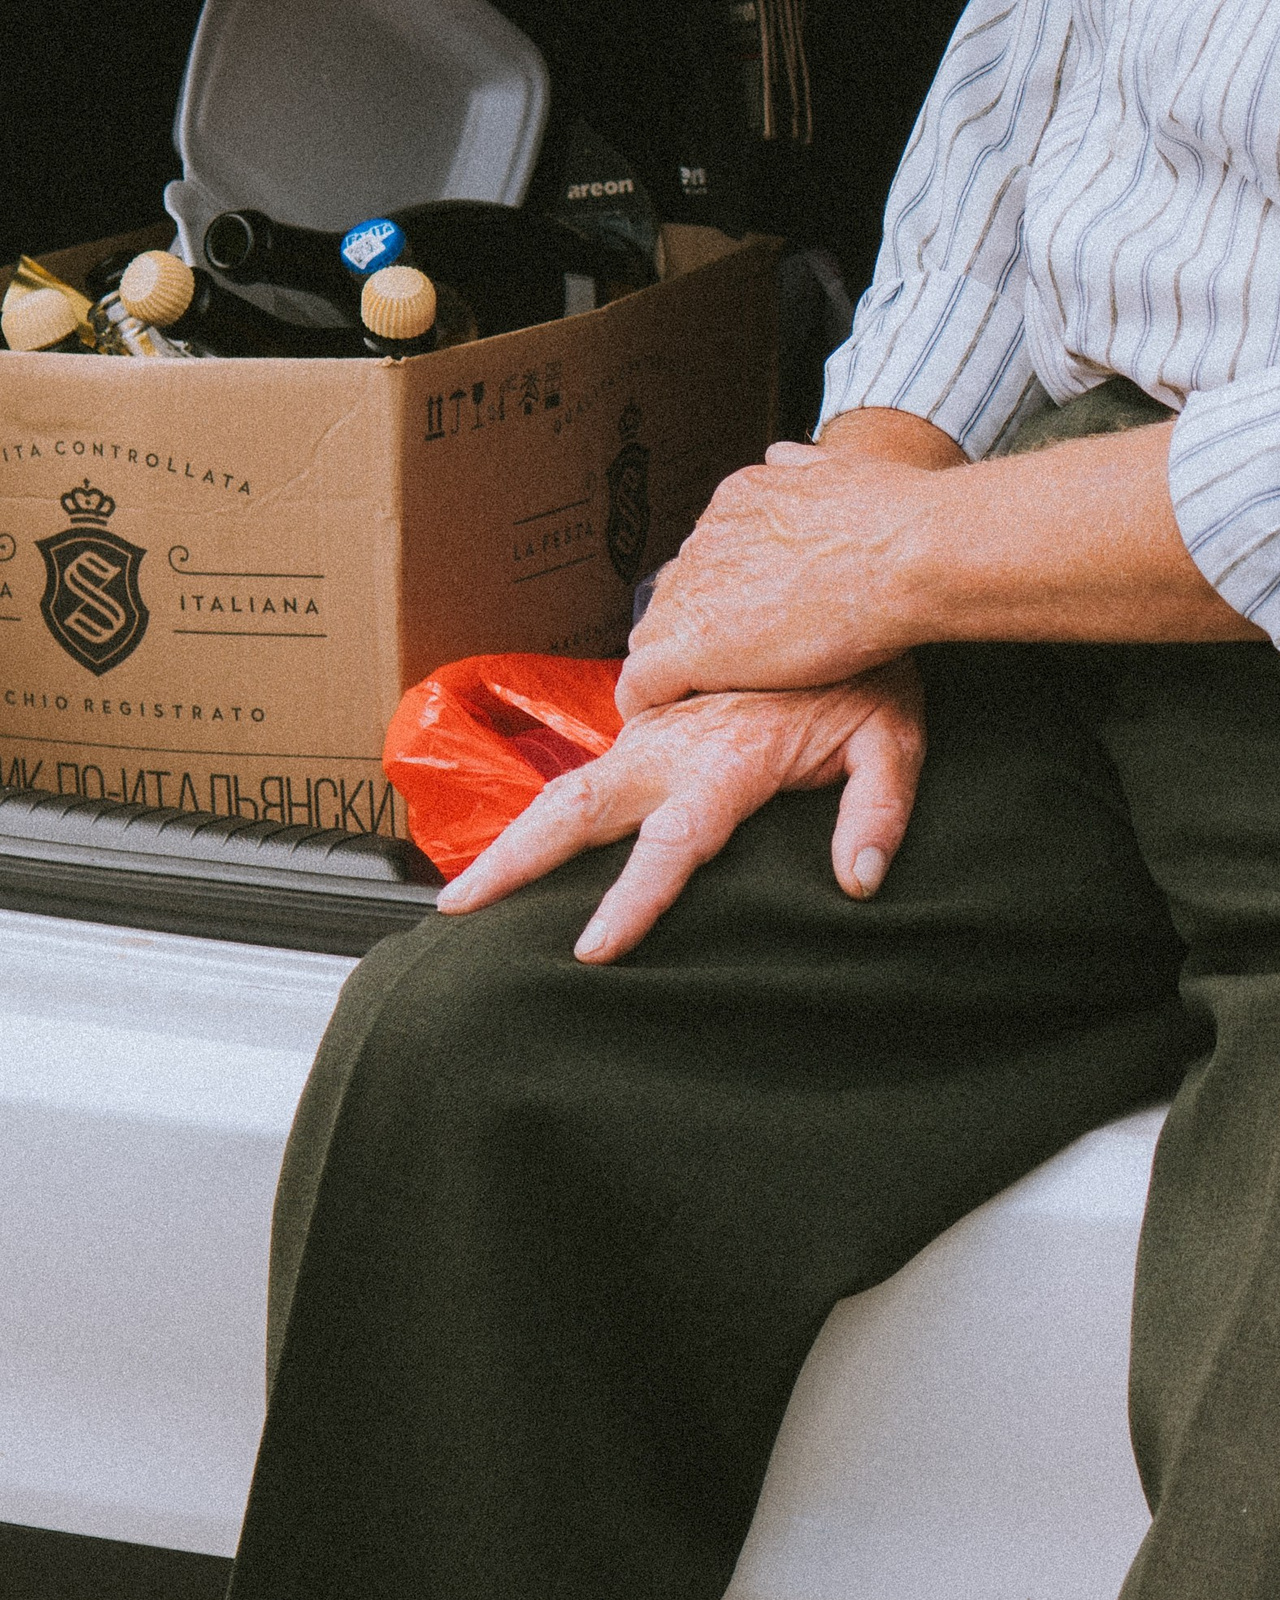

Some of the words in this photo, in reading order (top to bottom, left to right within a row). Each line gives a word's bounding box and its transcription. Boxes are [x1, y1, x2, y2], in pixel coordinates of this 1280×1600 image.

[567, 178, 634, 199] areon
[3, 443, 42, 462] ITA
[55, 440, 251, 496] CONTROLLATA
[180, 594, 320, 615] ITALIANA
[4, 689, 69, 711] CHIO
[84, 697, 266, 723] REGISTRATO
